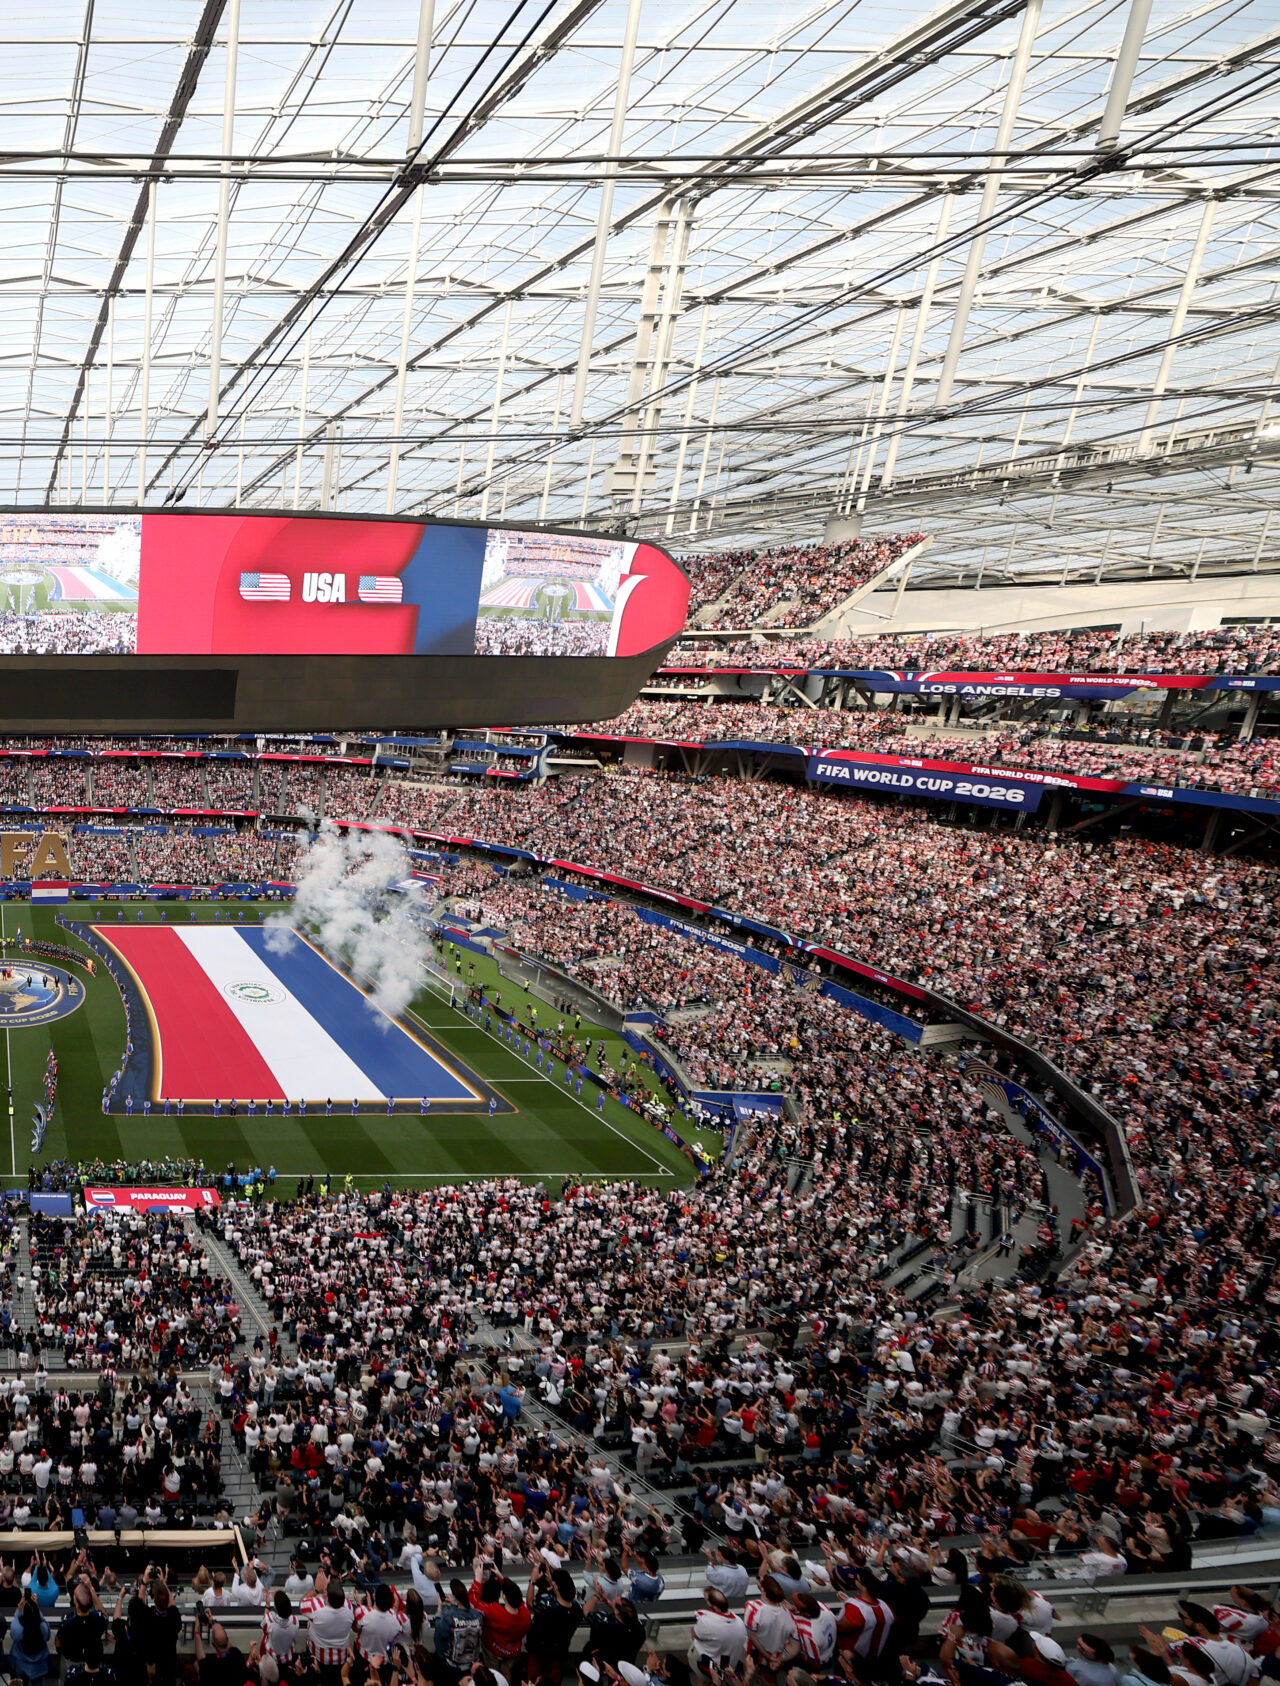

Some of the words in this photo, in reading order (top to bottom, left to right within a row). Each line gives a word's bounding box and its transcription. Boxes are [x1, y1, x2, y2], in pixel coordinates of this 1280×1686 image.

[301, 572, 346, 603] USA
[919, 684, 957, 693] LOS
[960, 685, 1061, 698] ANGELES
[971, 766, 990, 775] FIFA
[991, 769, 1024, 779] WORLD
[1024, 772, 1043, 782] CUP
[816, 763, 850, 780] FIFA
[853, 768, 914, 788] WORLD
[916, 777, 954, 793] CUP
[954, 782, 1026, 803] 2026
[1157, 788, 1173, 798] USA
[669, 919, 683, 929] FIFA
[707, 932, 721, 943] CUP
[721, 939, 746, 953] 2026
[29, 1010, 59, 1021] 2026
[524, 1028, 536, 1041] FIFA
[552, 1047, 566, 1061] FIFA
[625, 1099, 641, 1114] FIFA
[664, 1127, 678, 1144] FIFA
[354, 1408, 363, 1417] 10
